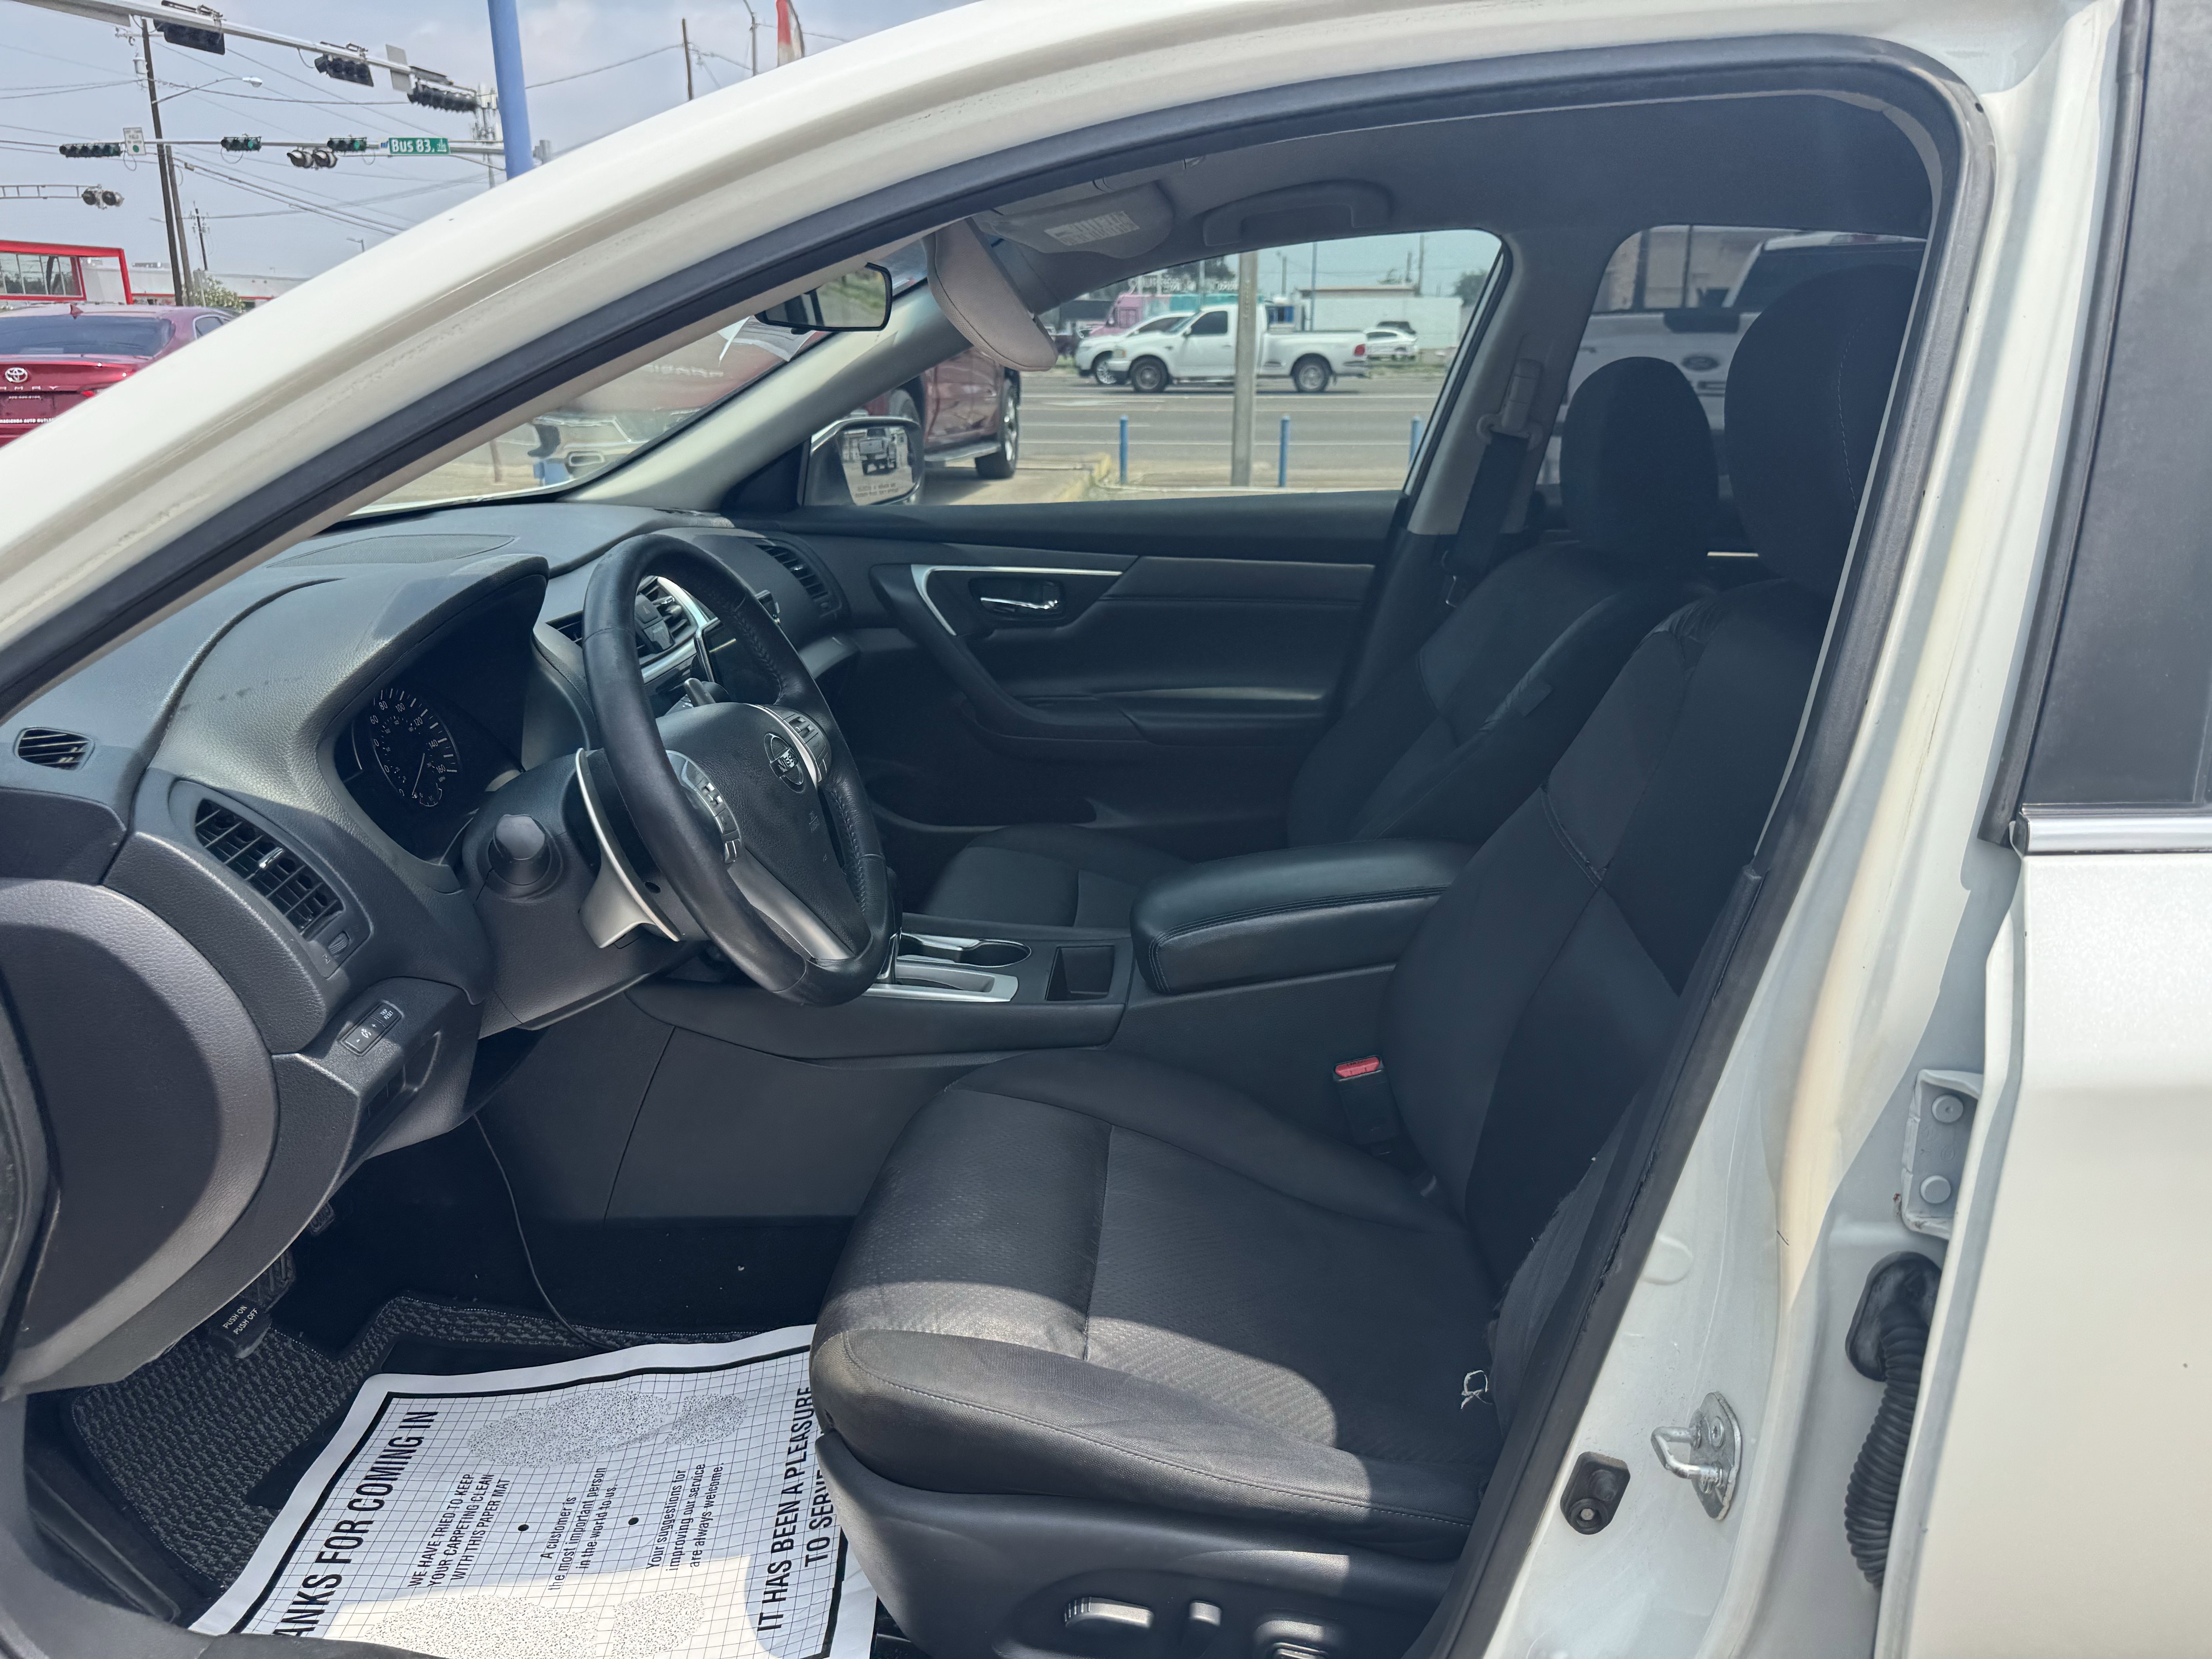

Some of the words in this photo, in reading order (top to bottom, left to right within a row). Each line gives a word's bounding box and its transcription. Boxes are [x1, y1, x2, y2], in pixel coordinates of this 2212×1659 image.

[379, 701, 388, 710] 80
[395, 703, 405, 713] 100
[370, 715, 378, 724] 60
[414, 717, 423, 726] 120
[429, 739, 438, 749] 140
[436, 764, 446, 773] 160
[223, 1313, 239, 1329] PUSH
[237, 1305, 247, 1314] ON
[233, 1319, 249, 1335] PUSH
[247, 1308, 258, 1320] OFF
[784, 1387, 814, 1481] PLEASURE
[587, 1468, 606, 1498] person
[605, 1484, 618, 1498] us.
[689, 1463, 705, 1498] service
[704, 1463, 724, 1508] welcome.
[781, 1482, 804, 1496] A
[599, 1500, 611, 1510] to
[684, 1501, 695, 1515] our
[273, 1574, 342, 1637] ANKS
[315, 1520, 374, 1564] FOR
[347, 1436, 424, 1511] COMING
[399, 1411, 438, 1428] IN
[407, 1571, 427, 1587] WE
[417, 1541, 441, 1567] HAVE
[431, 1513, 455, 1538] TRIED
[447, 1499, 463, 1510] TO
[455, 1474, 474, 1495] KEEP
[427, 1559, 453, 1587] YOUR
[443, 1505, 479, 1555] CARPETING
[471, 1474, 494, 1501] CLEAN
[451, 1555, 474, 1580] WITH
[465, 1530, 486, 1553] THIS
[476, 1501, 501, 1527] PAPER
[492, 1479, 510, 1497] MAT
[547, 1507, 572, 1549] customer
[565, 1500, 594, 1544] important
[590, 1512, 607, 1539] world
[646, 1546, 665, 1569] Your
[658, 1486, 682, 1542] suggestions
[672, 1470, 686, 1483] for
[694, 1511, 713, 1546] always
[771, 1499, 800, 1554] BEEN
[581, 1542, 597, 1558] the
[666, 1517, 694, 1571] improving
[805, 1537, 830, 1567] TO
[558, 1546, 576, 1571] most
[576, 1559, 591, 1569] in
[690, 1550, 702, 1568] are
[548, 1575, 565, 1590] the
[763, 1560, 792, 1607] HAS
[757, 1612, 783, 1632] IT
